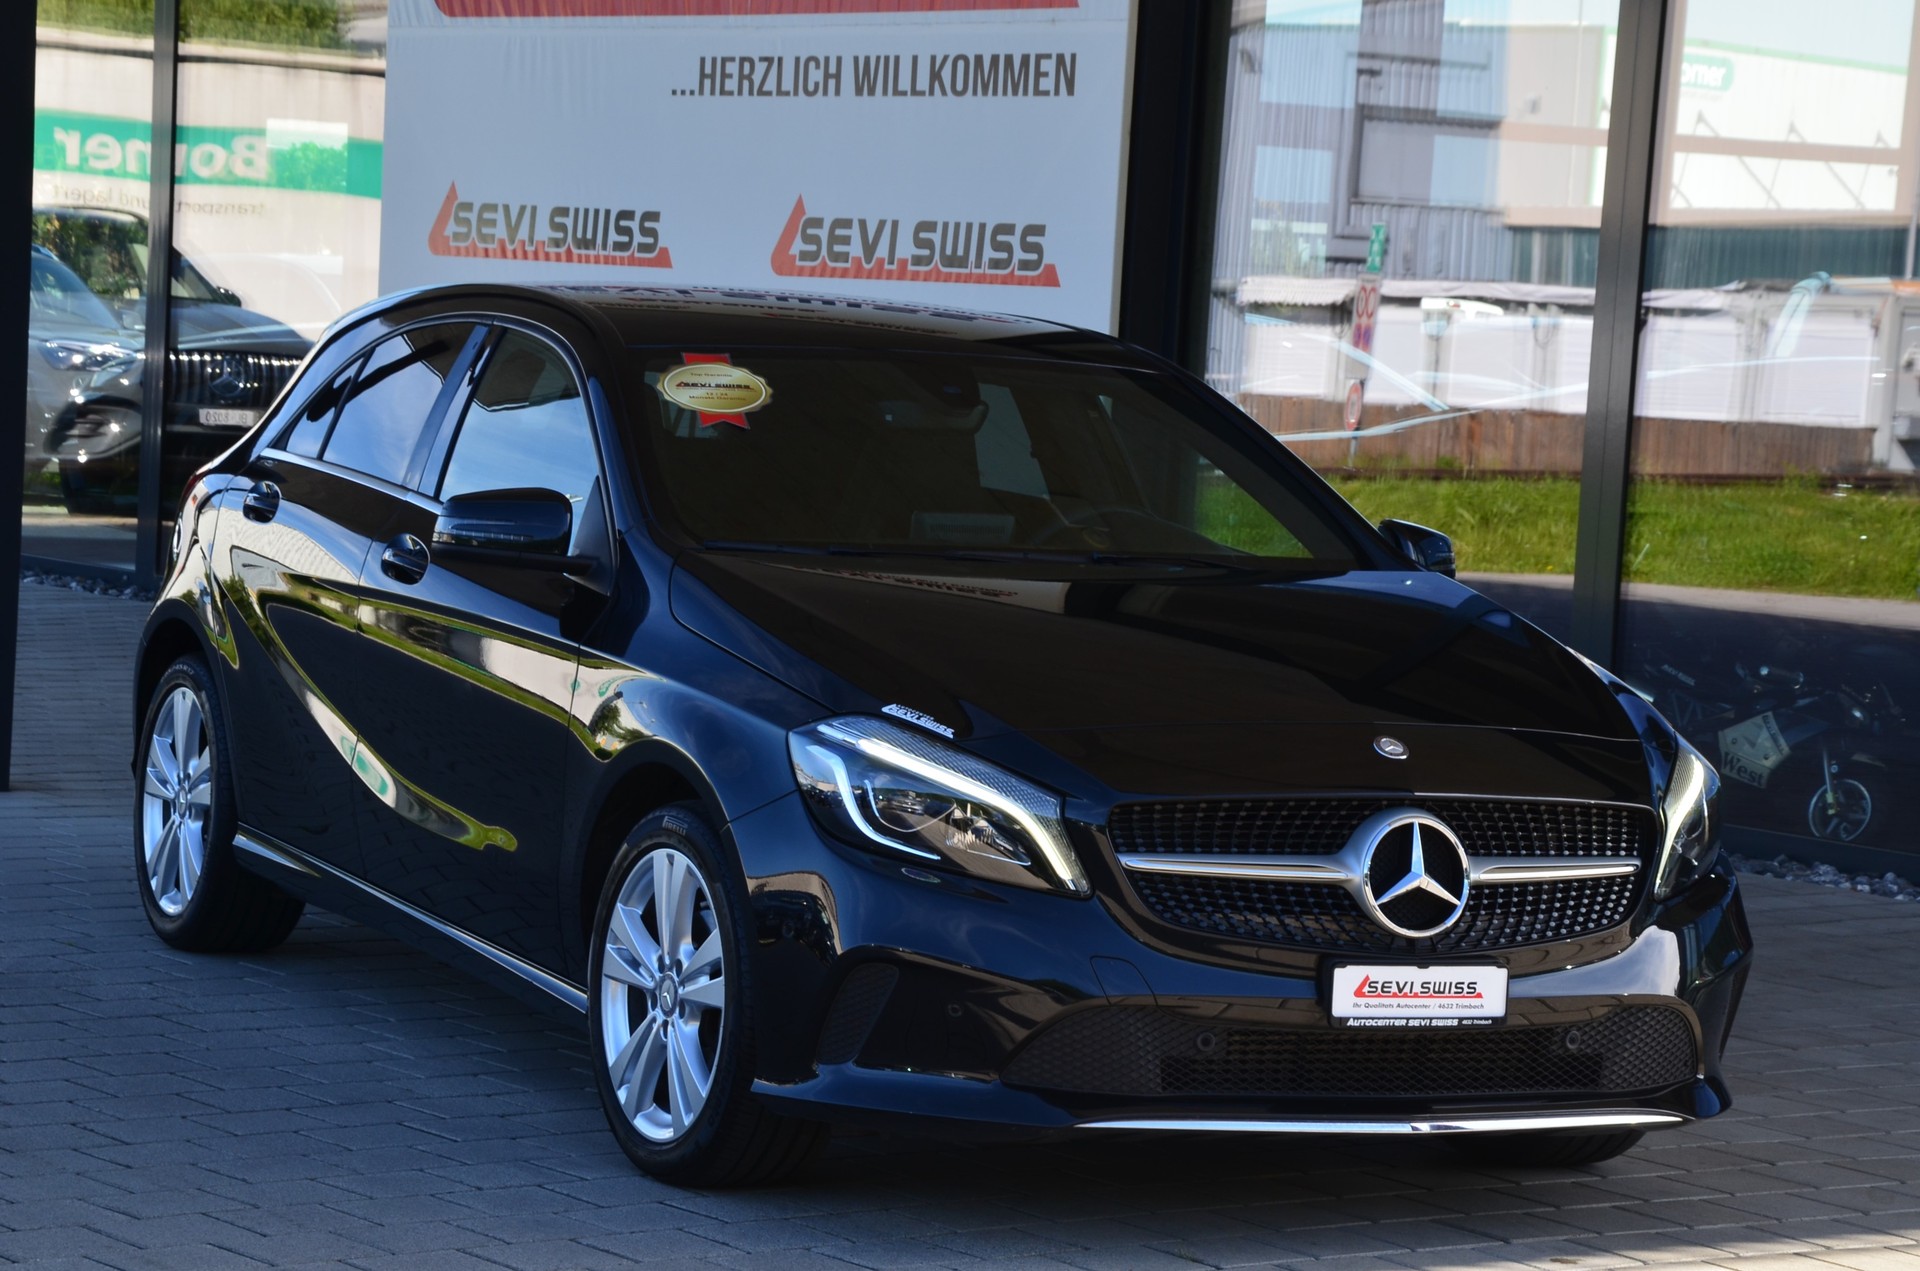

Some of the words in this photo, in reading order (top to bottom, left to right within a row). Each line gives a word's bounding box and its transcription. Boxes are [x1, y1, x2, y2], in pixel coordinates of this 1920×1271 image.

[671, 55, 843, 97] ...HERZLICH
[853, 52, 1078, 97] WILLKOMMEN
[451, 201, 538, 248] SEVI
[546, 206, 661, 255] SWISS
[796, 216, 900, 266] SEVI
[909, 220, 1047, 272] SWISS
[918, 716, 955, 736] SWISS
[1723, 751, 1765, 787] West
[662, 815, 688, 836] PIRELLI
[1366, 980, 1415, 995] SEVI
[1419, 981, 1478, 995] SWISS
[1407, 1019, 1430, 1027] SEVI
[1430, 1018, 1459, 1027] SWISS
